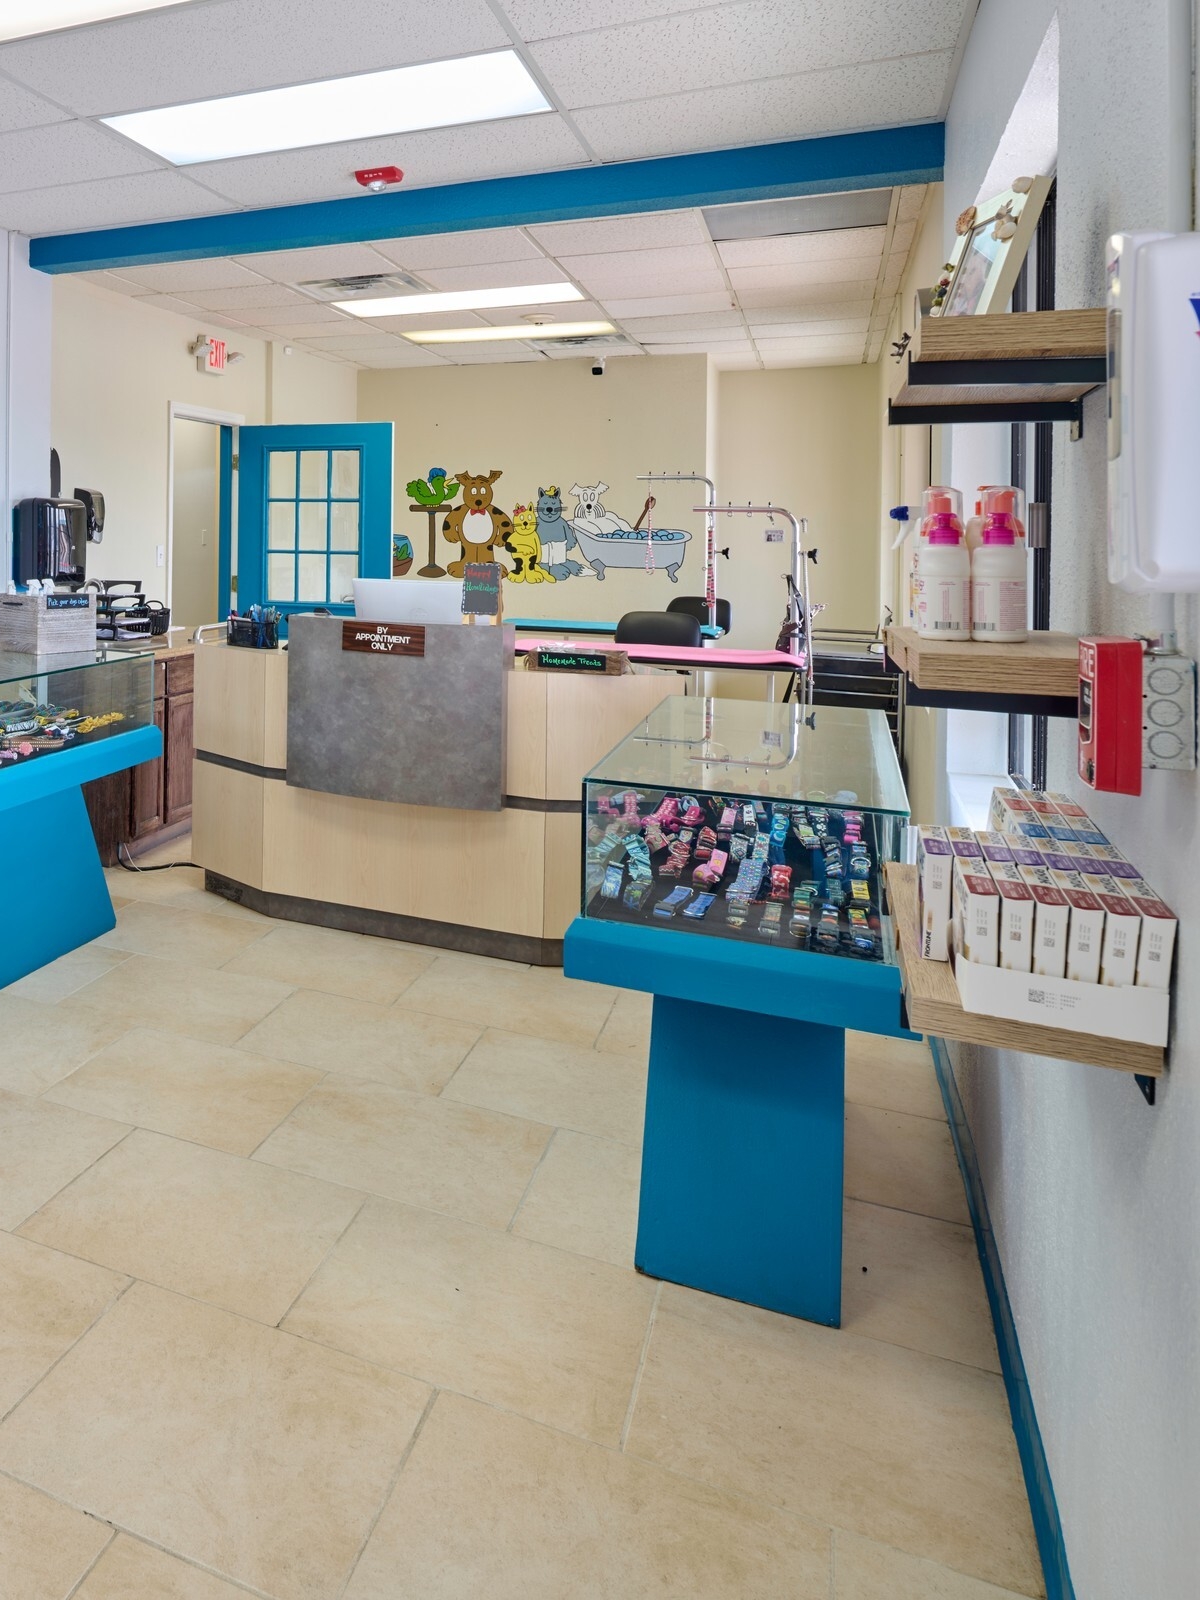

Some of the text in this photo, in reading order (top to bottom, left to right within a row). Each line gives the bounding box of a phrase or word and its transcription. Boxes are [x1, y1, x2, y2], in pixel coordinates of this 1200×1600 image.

[210, 339, 225, 369] EXIT
[377, 626, 388, 634] BY
[355, 633, 411, 644] APPOINTMENT
[371, 642, 393, 650] ONLY
[924, 930, 932, 957] FRONTLINE
